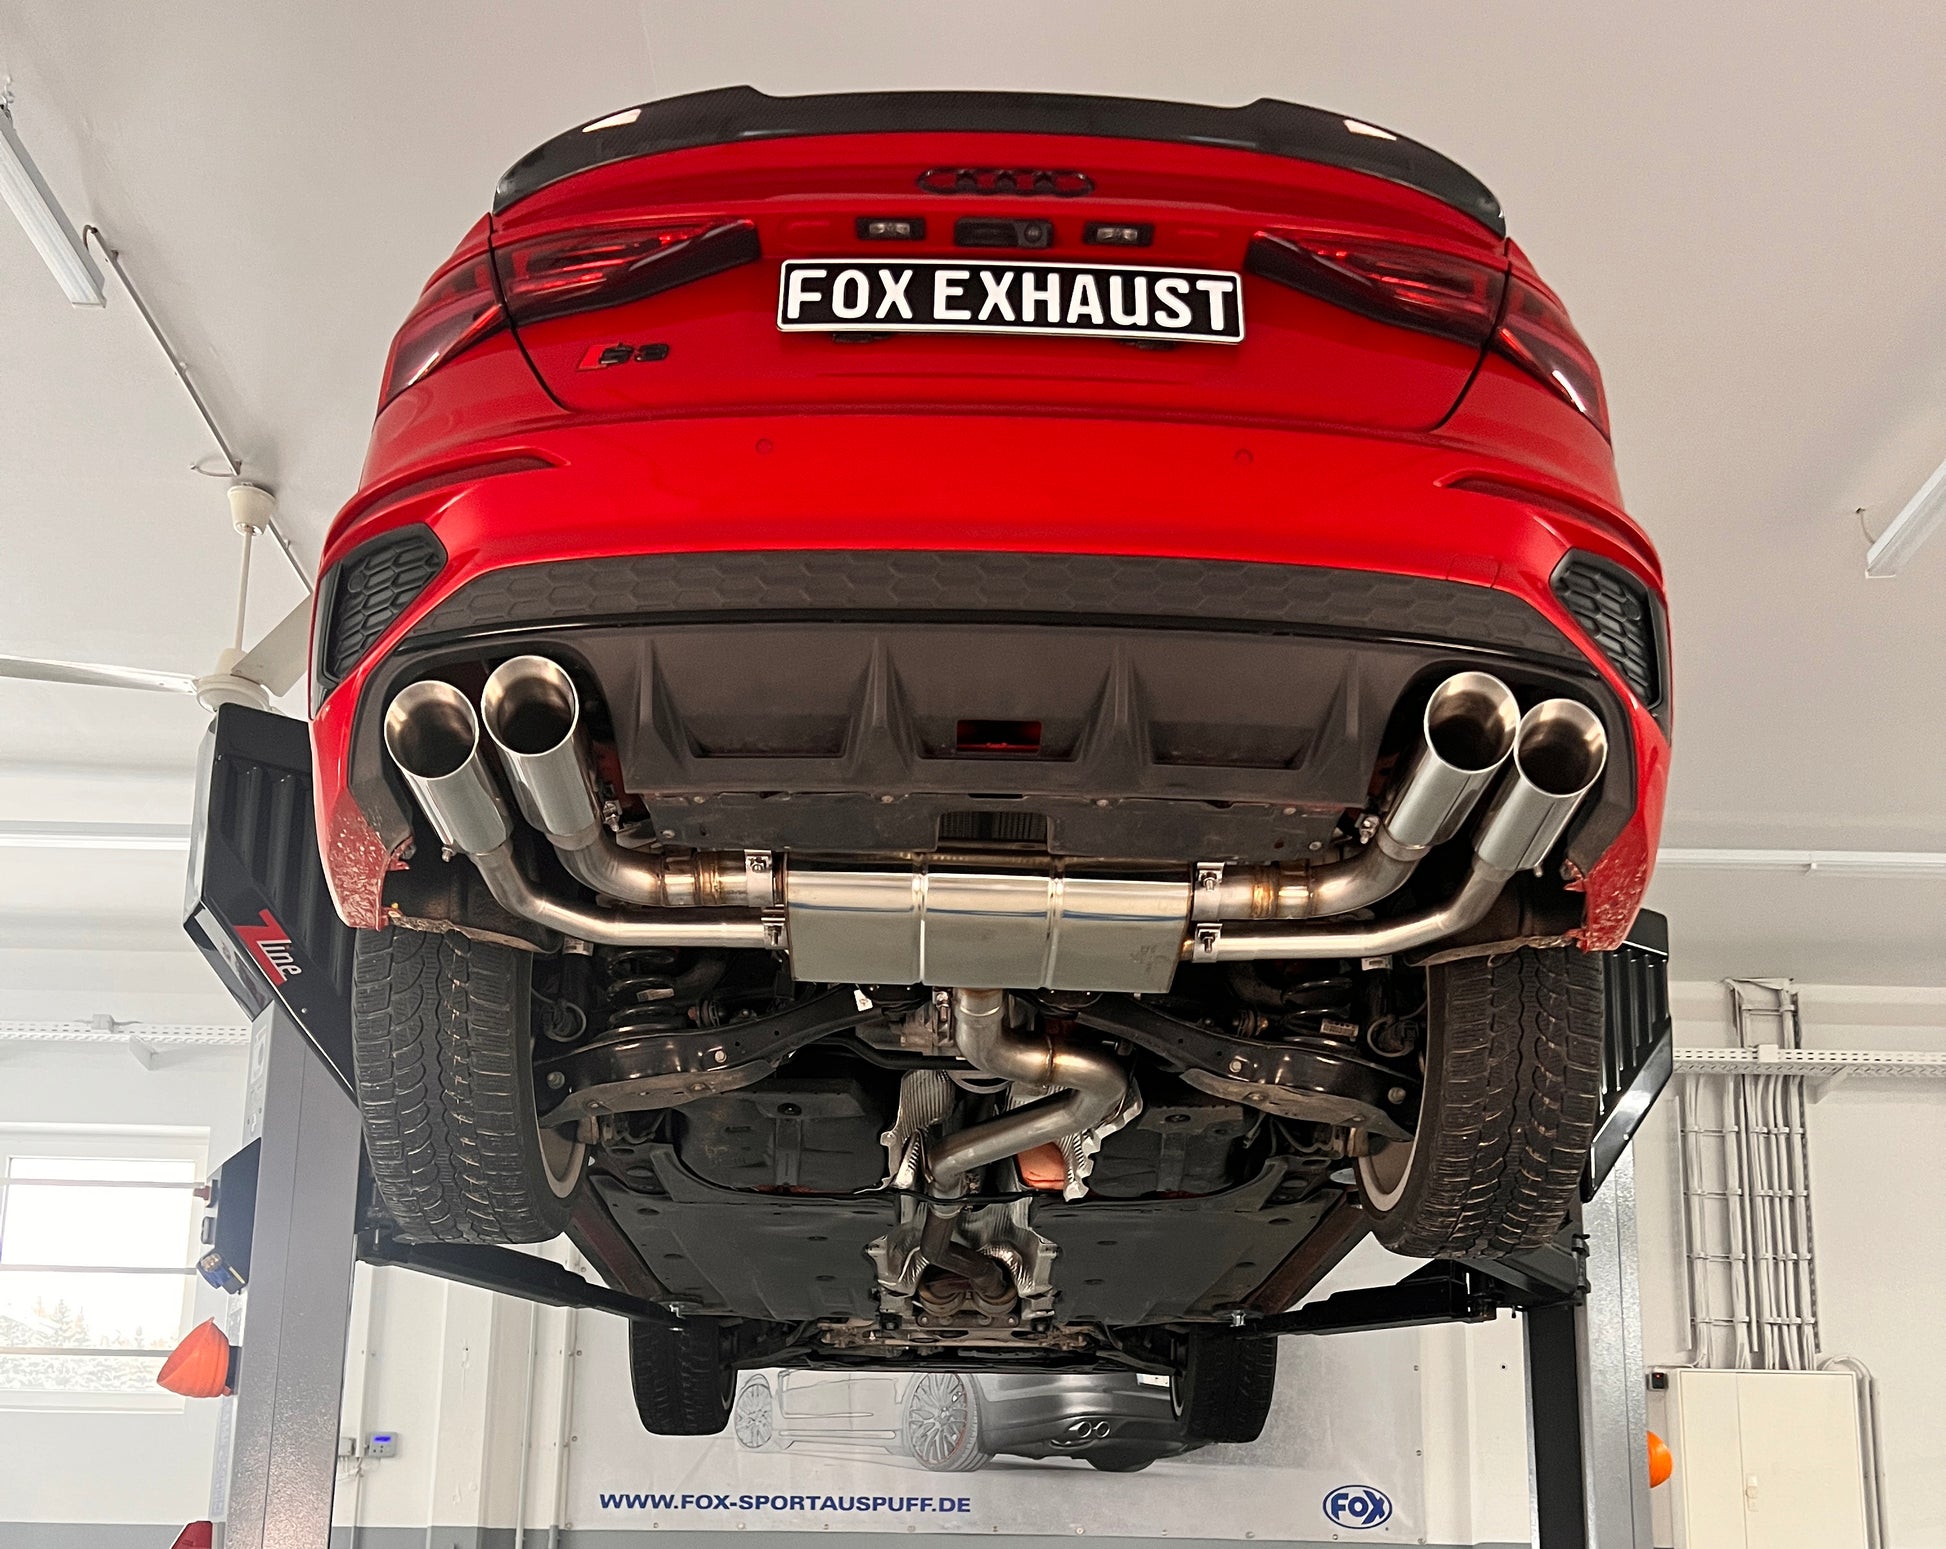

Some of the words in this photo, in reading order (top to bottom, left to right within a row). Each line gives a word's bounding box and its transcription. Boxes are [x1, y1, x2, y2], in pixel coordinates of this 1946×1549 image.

[786, 268, 914, 320] FOX
[933, 269, 1234, 331] EXHAUST
[599, 1493, 972, 1513] WWW.FOX-SPORTAUSPUFF.DE
[1330, 1489, 1386, 1526] FOX
